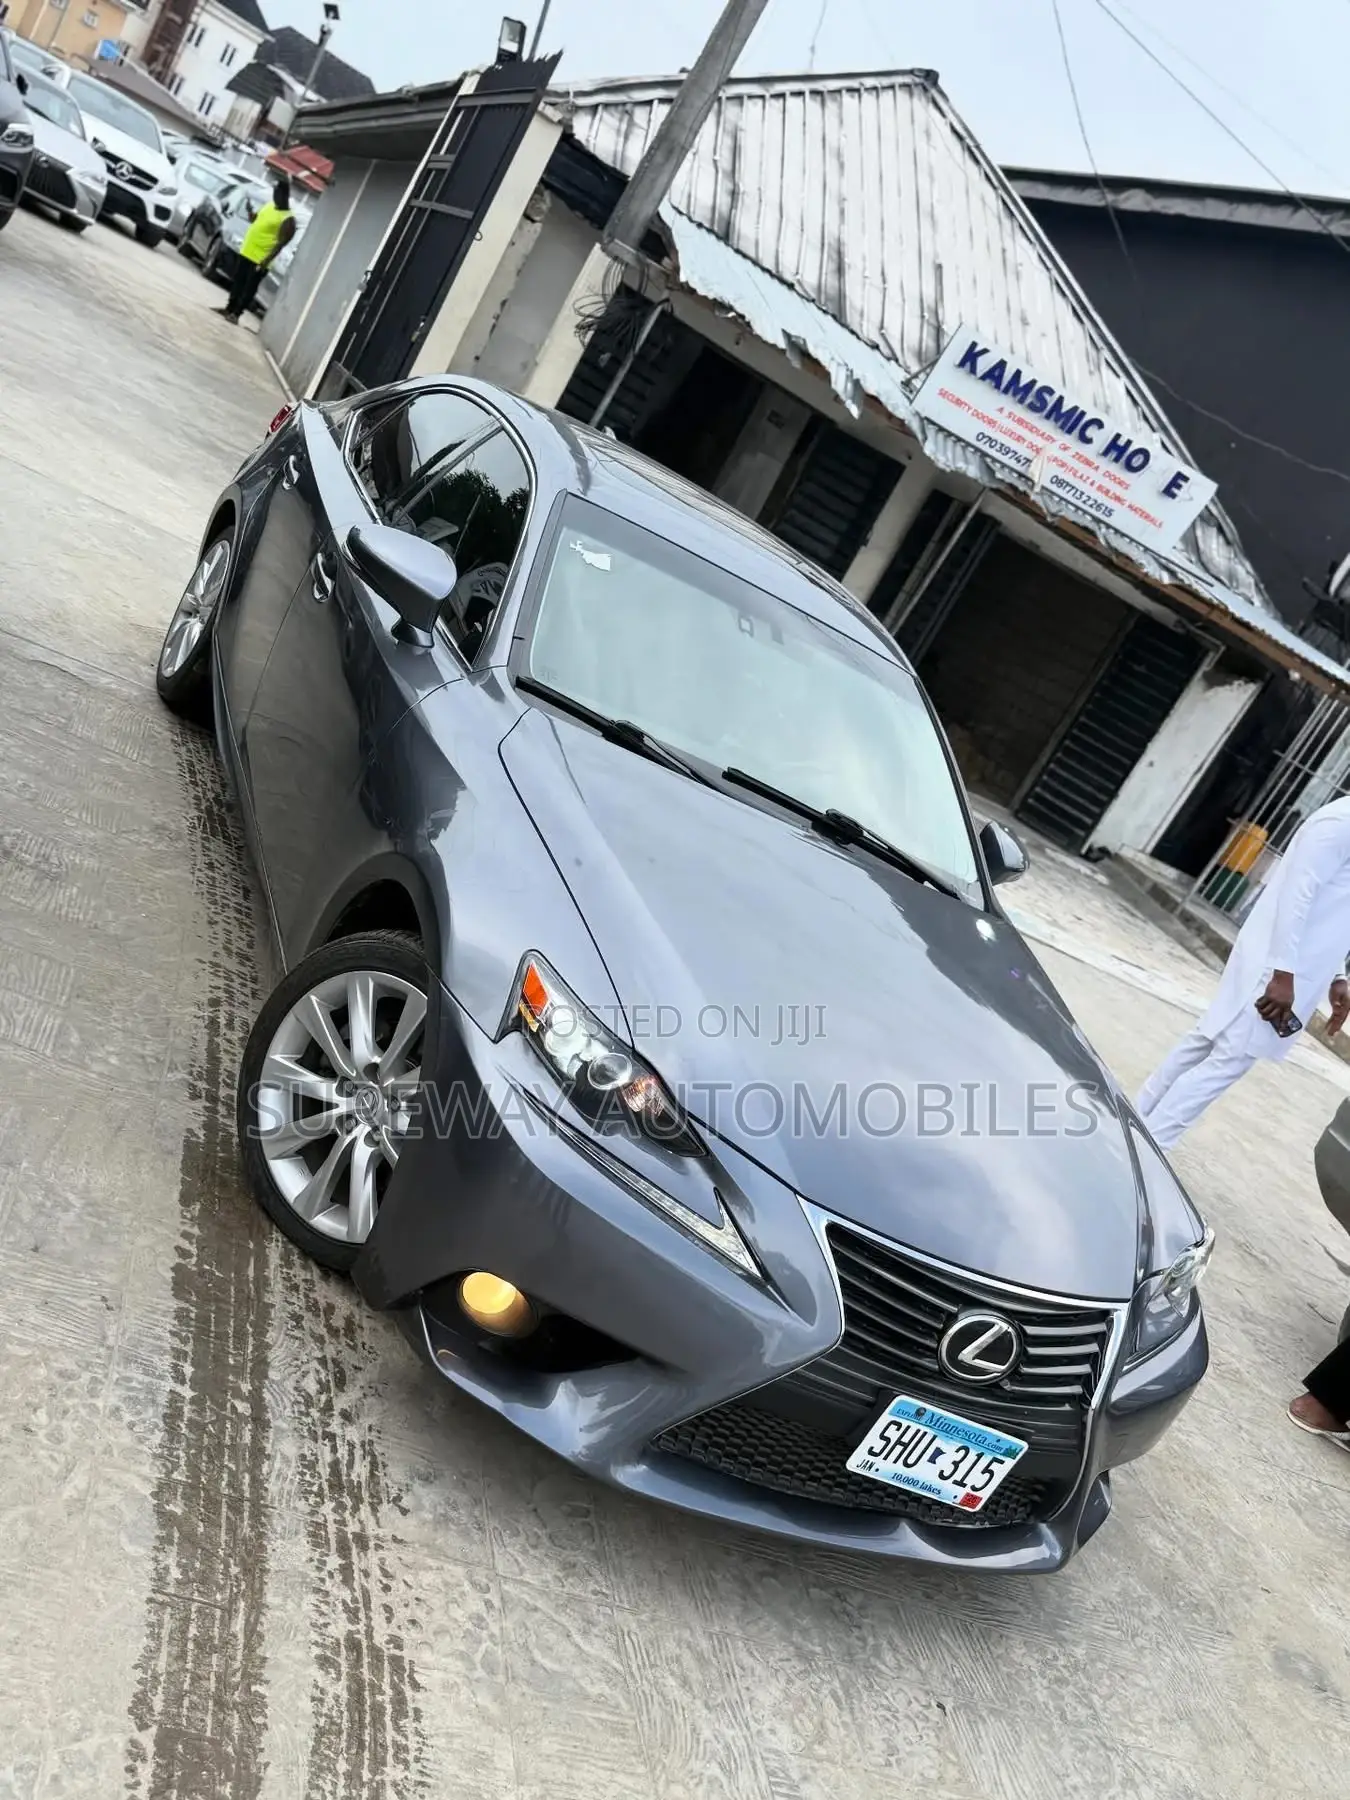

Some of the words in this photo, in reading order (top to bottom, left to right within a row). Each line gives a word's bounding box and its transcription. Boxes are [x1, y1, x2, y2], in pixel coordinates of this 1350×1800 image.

[957, 340, 1105, 445] KAMSMIC
[1101, 432, 1190, 500] HOE
[1007, 411, 1057, 444] SUBSIDIARY
[1059, 443, 1073, 452] OF
[1102, 470, 1131, 490] DOORS
[937, 387, 972, 416] SECURITY
[1096, 483, 1127, 506] BUILDING
[1127, 502, 1164, 529] MATERIALS
[856, 1459, 875, 1472] JAN
[867, 1420, 938, 1469] SHU
[938, 1445, 1005, 1492] 315
[891, 1472, 920, 1488] 10,000
[919, 1481, 943, 1495] lakes
